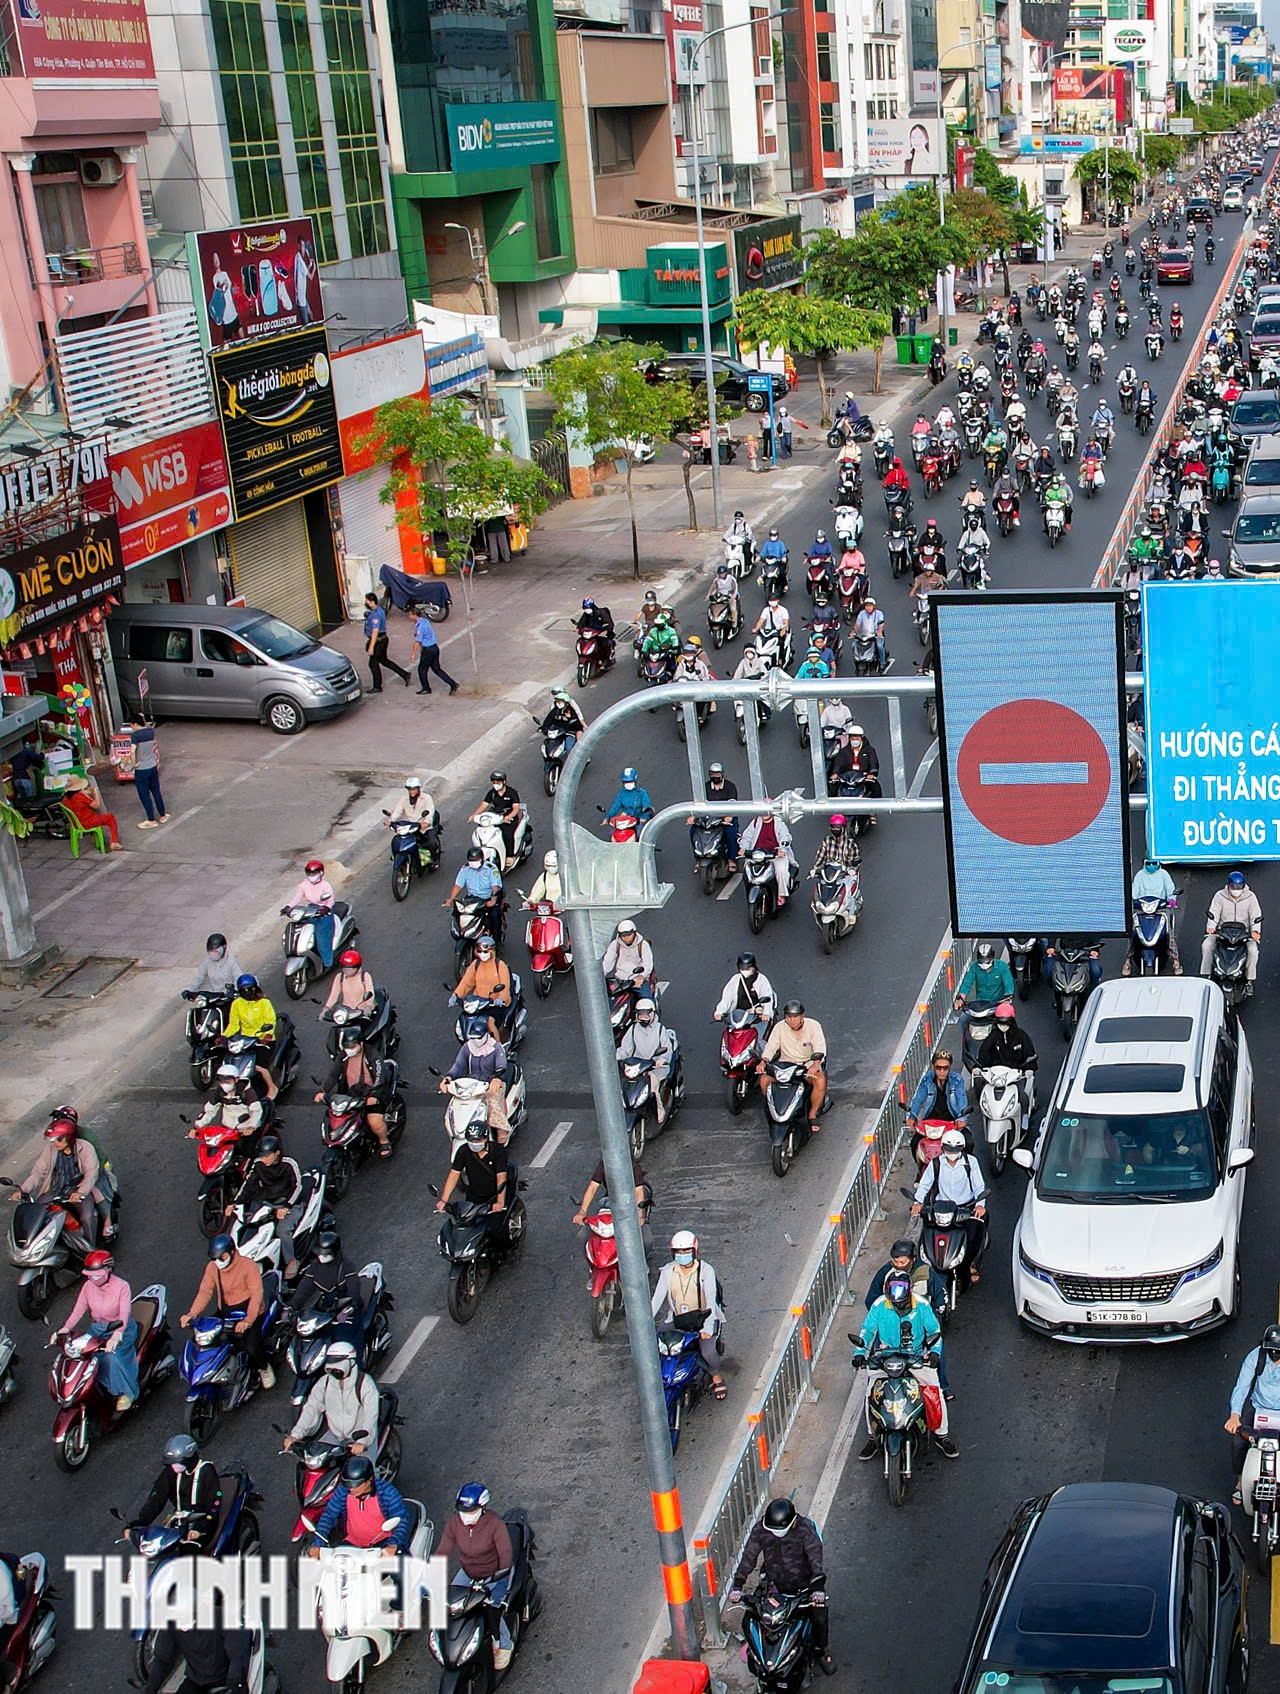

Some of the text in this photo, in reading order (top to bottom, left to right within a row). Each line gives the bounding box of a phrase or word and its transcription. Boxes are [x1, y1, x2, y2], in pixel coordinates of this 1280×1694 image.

[458, 124, 483, 151] BIDV
[247, 425, 323, 460] PICKLEBALL FOOTBALL
[68, 443, 109, 489] 79K
[142, 451, 188, 496] MSB
[20, 555, 53, 602] MÊ
[57, 528, 114, 585] CUỐN
[1160, 722, 1244, 758] HƯỚNG
[1173, 775, 1196, 801] ĐI
[1183, 812, 1265, 846] ĐƯỜNG
